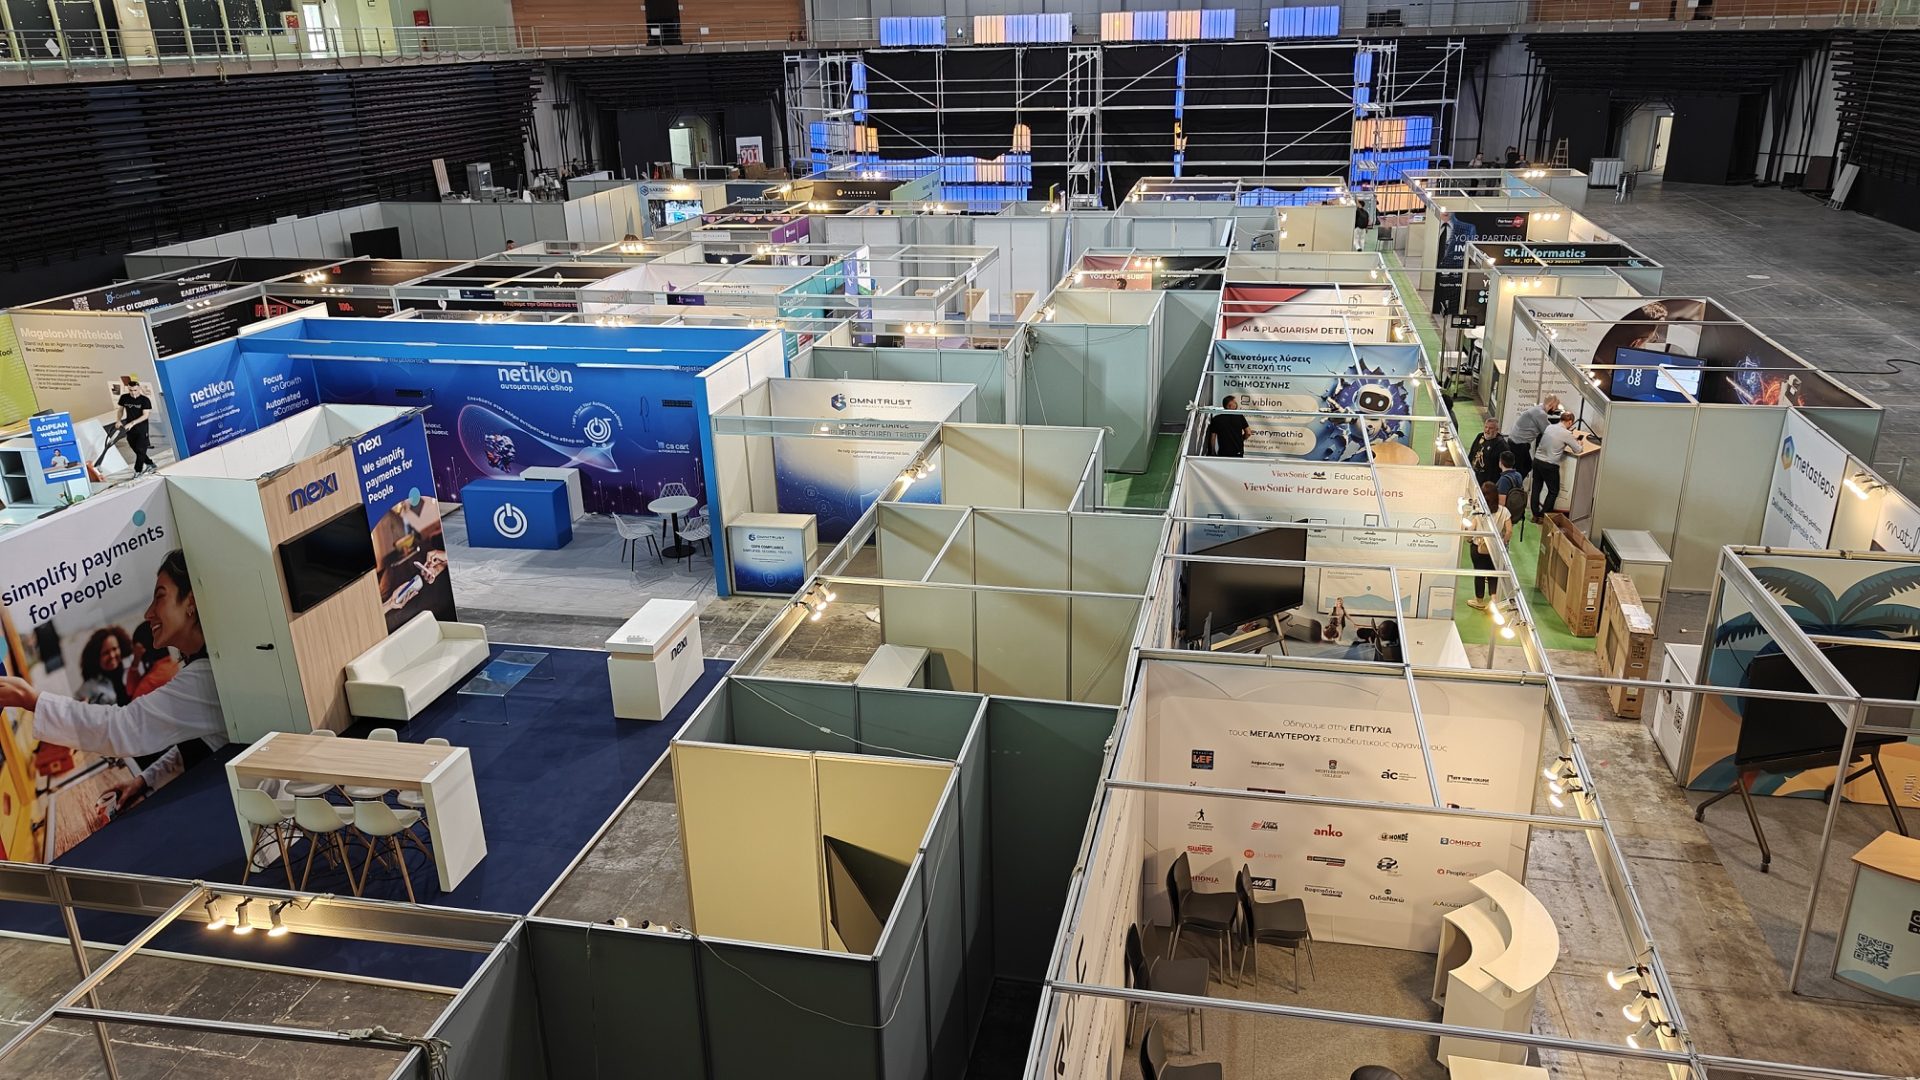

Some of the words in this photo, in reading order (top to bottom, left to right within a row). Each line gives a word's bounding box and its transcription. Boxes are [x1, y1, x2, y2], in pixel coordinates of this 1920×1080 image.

[1454, 234, 1479, 242] YOUR
[1262, 326, 1319, 334] PLAGIARISM
[1224, 353, 1278, 363] Καινοτόμες
[1279, 353, 1311, 364] λύσεις
[498, 365, 573, 383] netikon
[1246, 362, 1275, 372] εποχή
[1277, 363, 1292, 372] της
[263, 373, 284, 386] Focus
[271, 384, 279, 393] on
[279, 376, 302, 391] Growth
[1223, 380, 1291, 390] ΝΟΗΜΟΣΥΝΗΣ
[1627, 376, 1641, 387] 08
[190, 379, 235, 404] netikon
[500, 383, 550, 392] αυτοματισμοί
[550, 383, 574, 393] eShop
[265, 390, 301, 411] Automated
[273, 398, 310, 417] eCommerce
[849, 397, 912, 406] OMNITRUST
[36, 421, 69, 432] ΔΩΡΕΑΝ
[40, 429, 68, 438] website
[357, 434, 382, 455] nexi
[361, 463, 376, 475] We
[375, 446, 406, 469] simplify
[365, 465, 402, 492] payments
[401, 458, 414, 472] for
[1271, 470, 1309, 479] ViewSonic
[1334, 472, 1375, 481] Educatio
[1793, 453, 1836, 499] metasteps
[288, 472, 339, 513] nexi
[367, 483, 395, 504] People
[1243, 482, 1293, 493] ViewSonic
[1296, 486, 1350, 496] Hardware
[1352, 487, 1405, 498] Soluions
[1, 561, 78, 607] simplify
[81, 525, 165, 576] payments
[28, 601, 57, 624] for
[61, 572, 123, 610] People
[670, 635, 688, 661] nexi
[1282, 719, 1325, 731] Οδηγούμε
[1327, 723, 1348, 732] στην
[1349, 724, 1392, 734] ΕΠΙΤΥΧΙΑ
[1228, 729, 1249, 738] τους
[1249, 729, 1321, 742] ΜΕΓΑΛΥΤΕΡΟΥΣ
[1313, 824, 1344, 838] anko
[1388, 833, 1409, 841] MONDE
[1449, 839, 1482, 848] ΟΜΗΡΟΣ
[1445, 869, 1478, 878] PeopleCert
